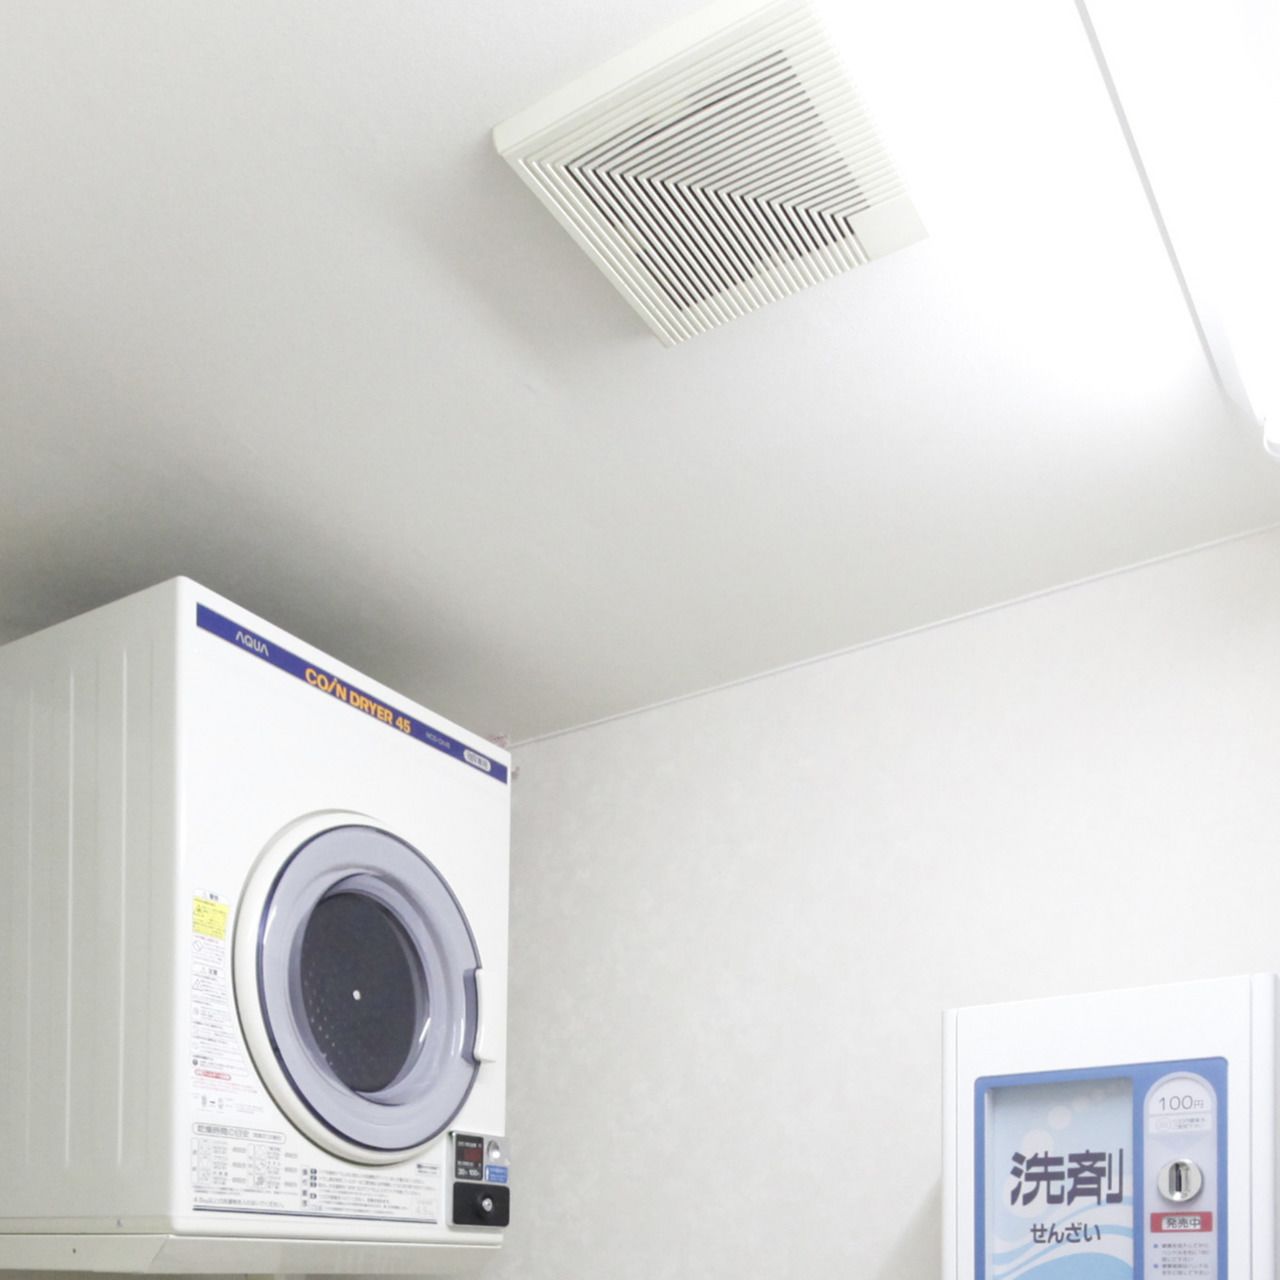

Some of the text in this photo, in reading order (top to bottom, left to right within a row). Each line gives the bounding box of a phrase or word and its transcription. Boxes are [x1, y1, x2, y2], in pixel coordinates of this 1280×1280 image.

[235, 630, 269, 657] AQUA
[349, 689, 394, 725] DRYER
[395, 715, 412, 735] 45
[1158, 1095, 1204, 1111] 100円
[1010, 1148, 1124, 1206] 洗剤
[1030, 1221, 1102, 1244] せんざい
